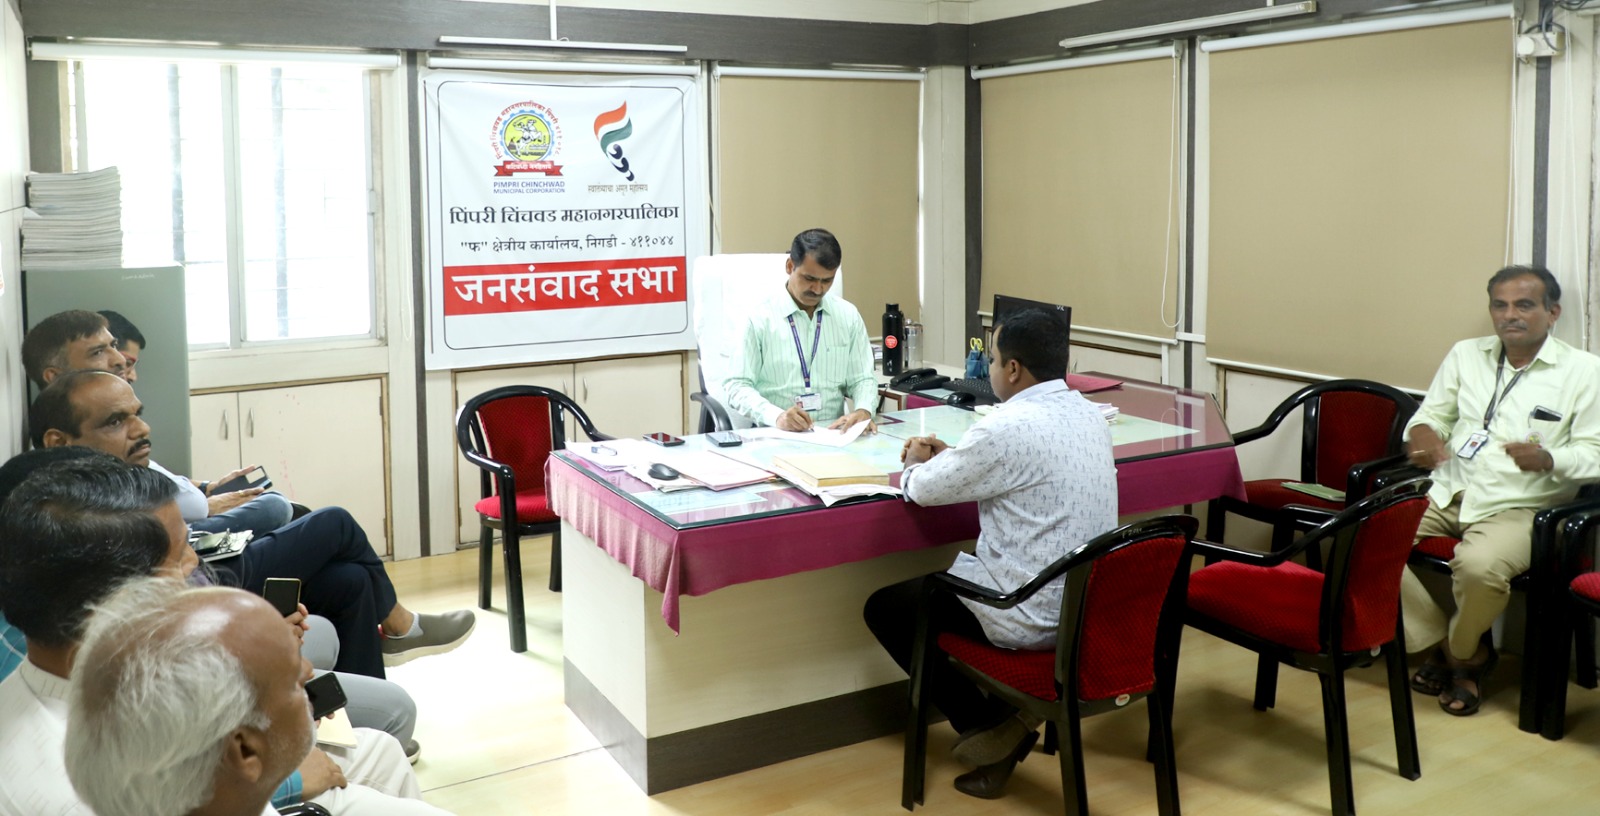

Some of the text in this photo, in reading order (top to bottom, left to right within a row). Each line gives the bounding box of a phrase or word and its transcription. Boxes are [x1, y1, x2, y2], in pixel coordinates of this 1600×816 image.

[449, 203, 680, 224] पिंपरी चिंचवड महानगरपालिका
[492, 237, 527, 252] क्षेत्रीय
[529, 236, 583, 251] कार्यालय,
[585, 234, 618, 249] निगडी
[629, 235, 674, 248] ४११०४४
[451, 265, 678, 304] जनसंवाद सभा
